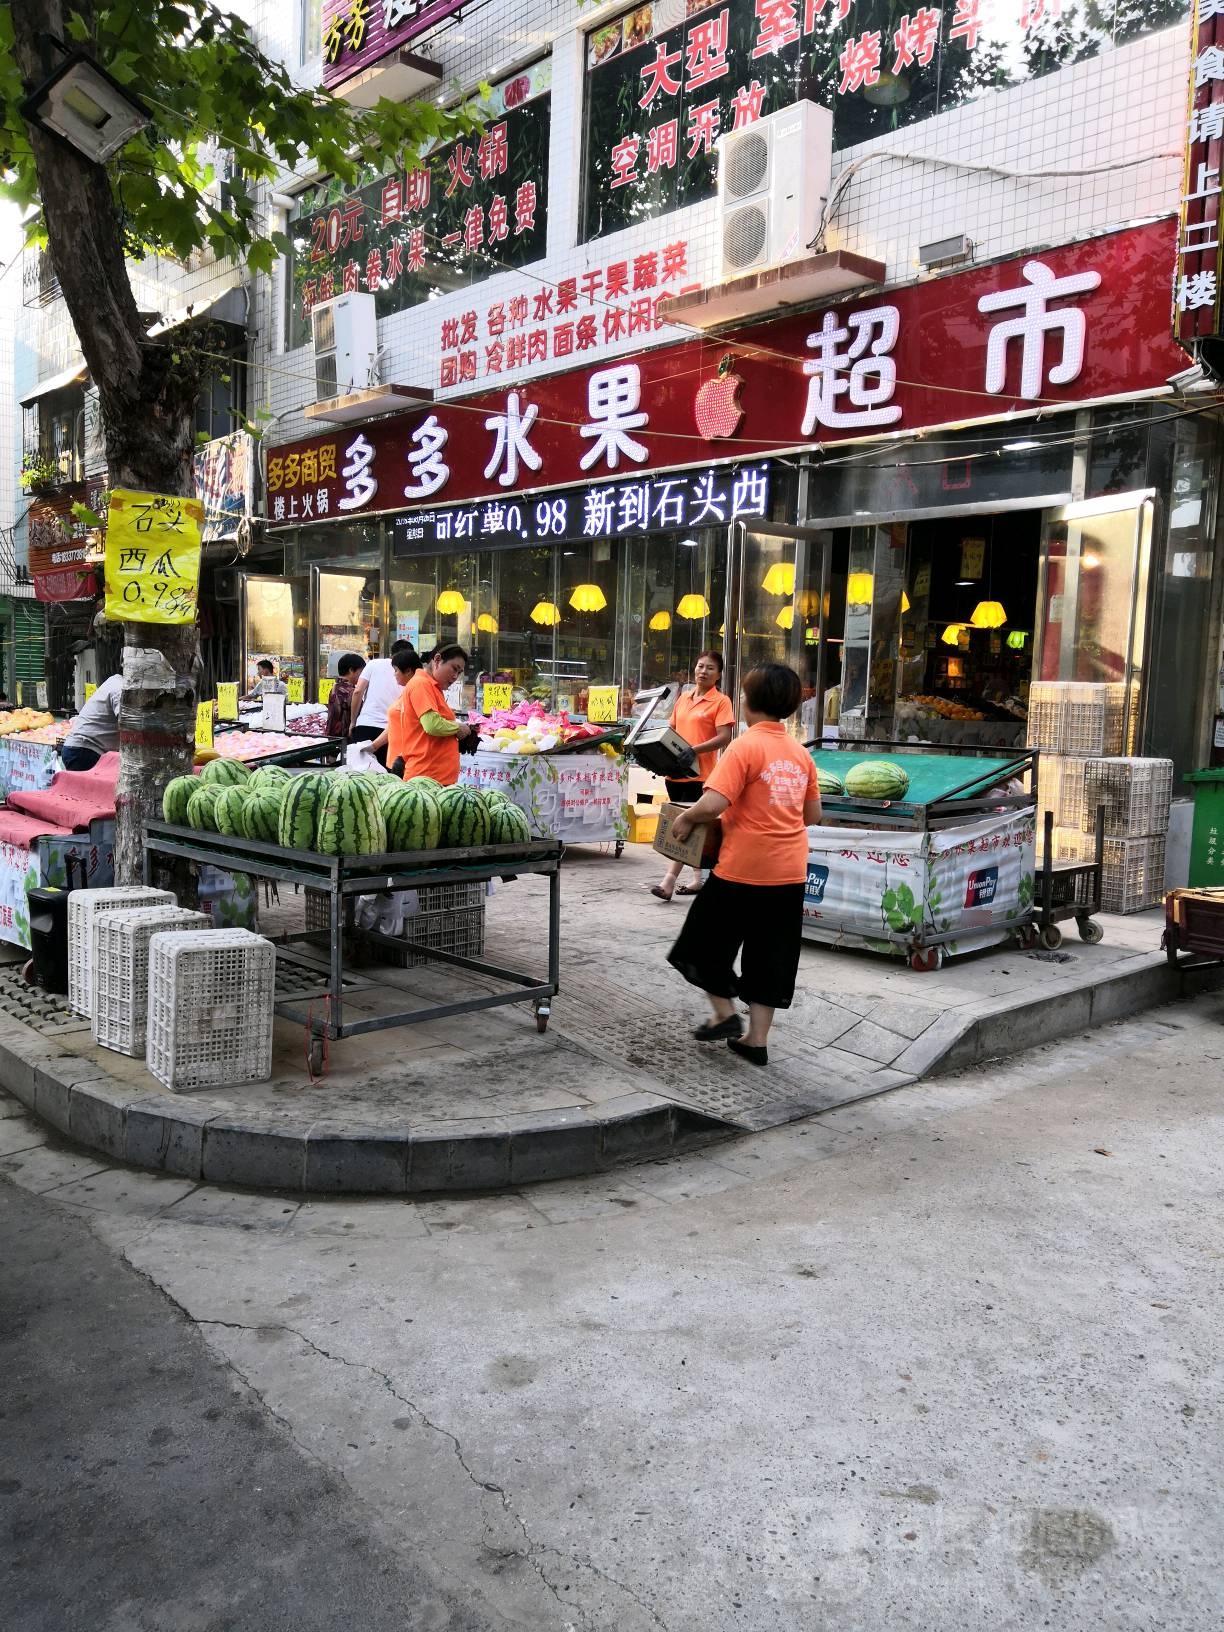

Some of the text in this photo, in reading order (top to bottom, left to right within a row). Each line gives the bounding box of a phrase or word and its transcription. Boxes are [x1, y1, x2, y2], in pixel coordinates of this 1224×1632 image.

[638, 8, 729, 109] 大型
[610, 80, 767, 190] 空调开放
[310, 121, 508, 263] 20元 自助 火锅
[441, 180, 537, 256] 一律免费
[441, 240, 688, 351] 批发 各种水果干果蔬菜
[441, 283, 702, 388] 团购 冷鲜肉面条休闲
[337, 363, 651, 510] 多多水果
[801, 259, 1103, 436] 超市
[268, 444, 337, 492] 多多商贸
[274, 488, 329, 521] 楼上火锅
[582, 464, 769, 536] 新到石头西
[128, 505, 185, 534] 石头
[119, 548, 181, 577] 西瓜
[968, 876, 997, 890] UnionPay
[979, 886, 994, 899] 银联
